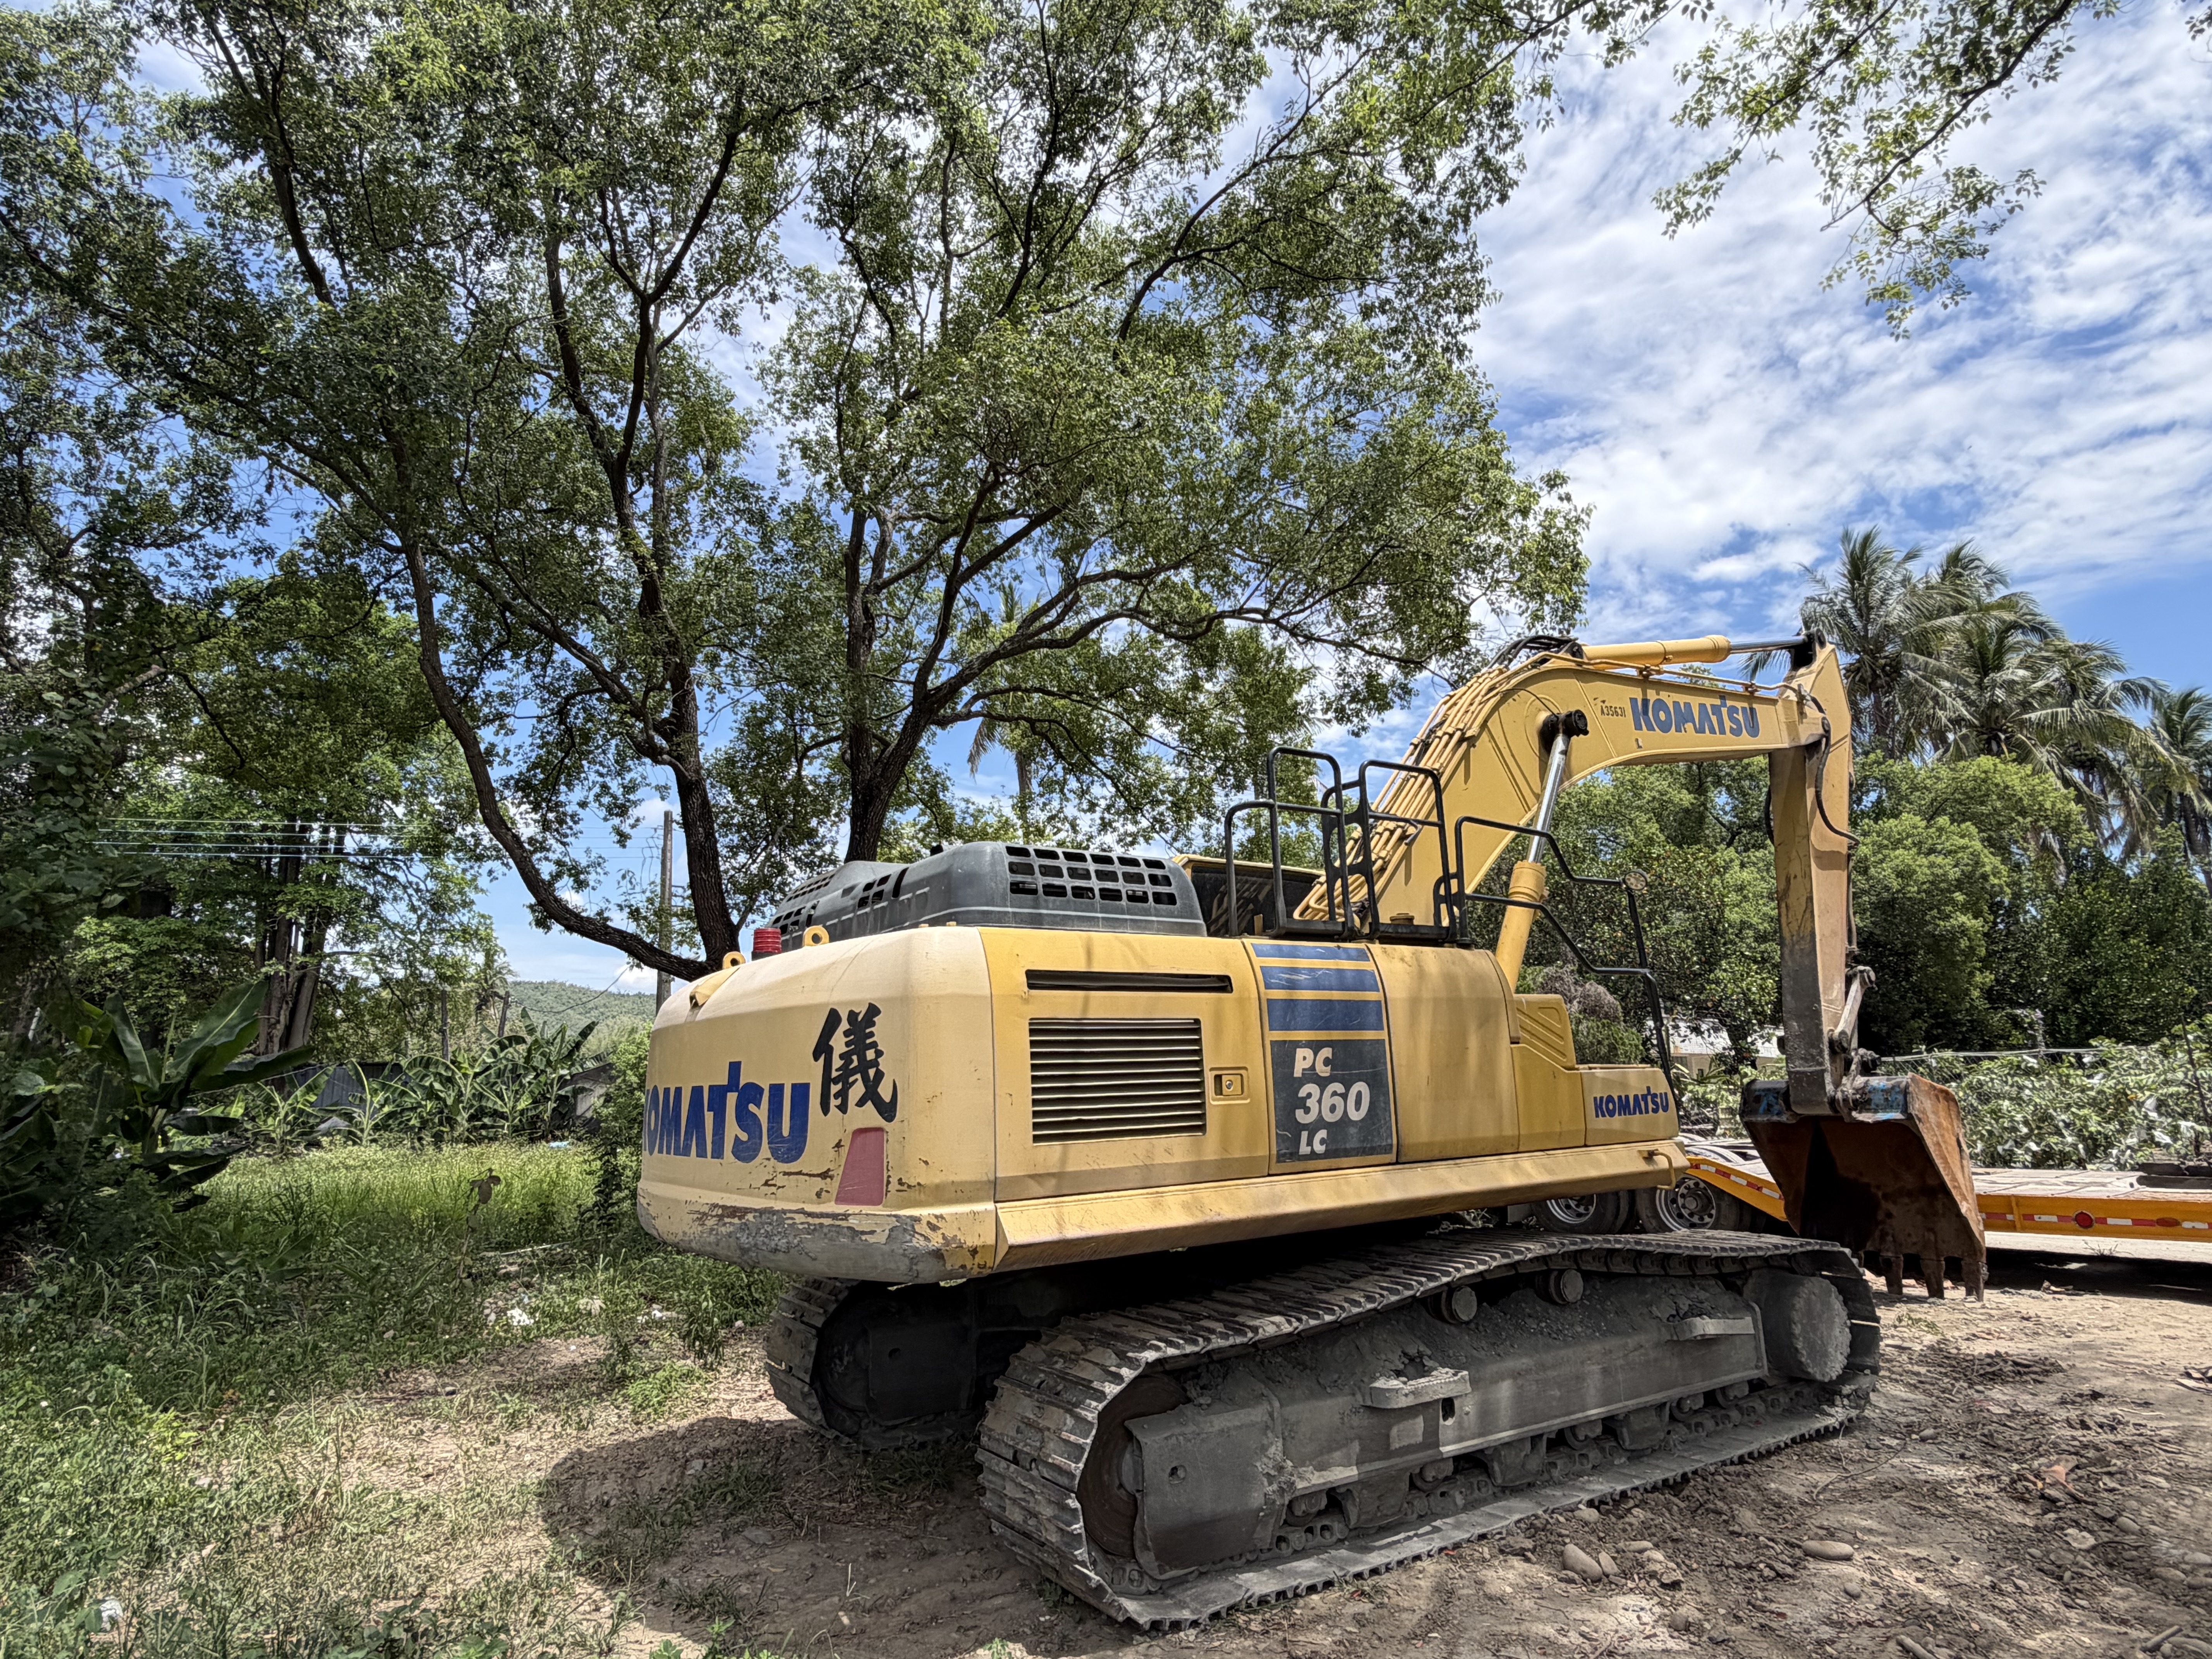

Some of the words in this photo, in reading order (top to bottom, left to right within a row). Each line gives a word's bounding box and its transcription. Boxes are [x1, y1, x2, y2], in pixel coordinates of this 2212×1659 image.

[1629, 695, 1760, 738] KOMATSU
[812, 1002, 898, 1123] 儀
[1293, 1047, 1332, 1077] PC
[1295, 1082, 1370, 1123] 360
[1594, 1086, 1669, 1118] KOMATSU
[1298, 1129, 1327, 1155] LC
